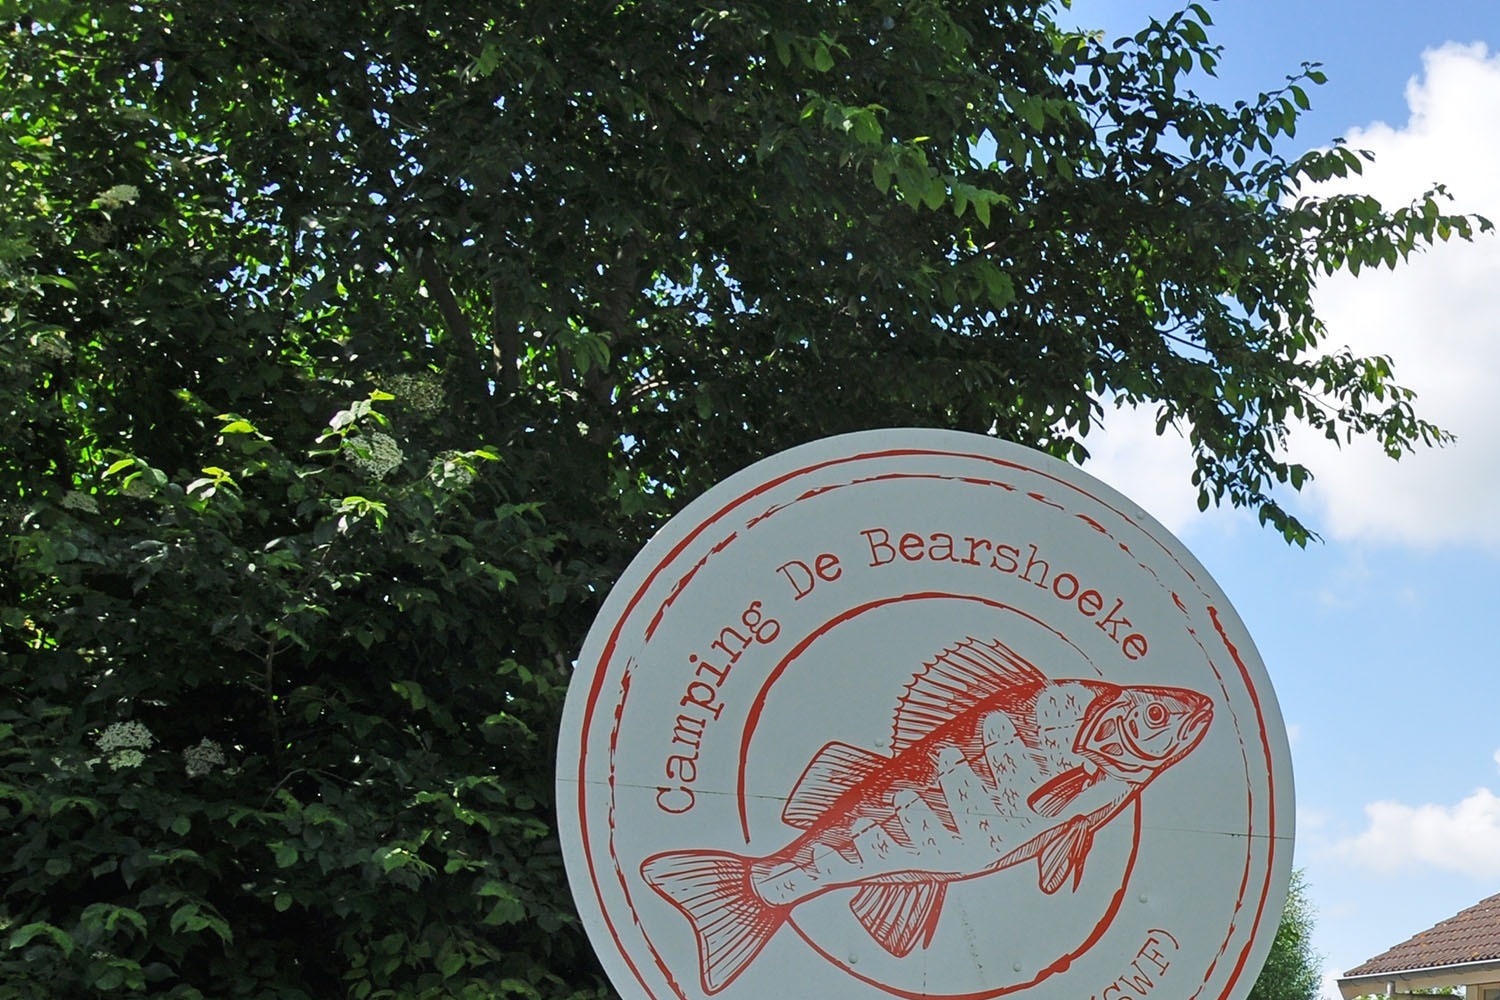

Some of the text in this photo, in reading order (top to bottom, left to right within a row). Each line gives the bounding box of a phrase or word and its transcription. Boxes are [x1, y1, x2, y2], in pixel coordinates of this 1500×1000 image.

[656, 526, 1149, 815] Camping De Bearshoeke
